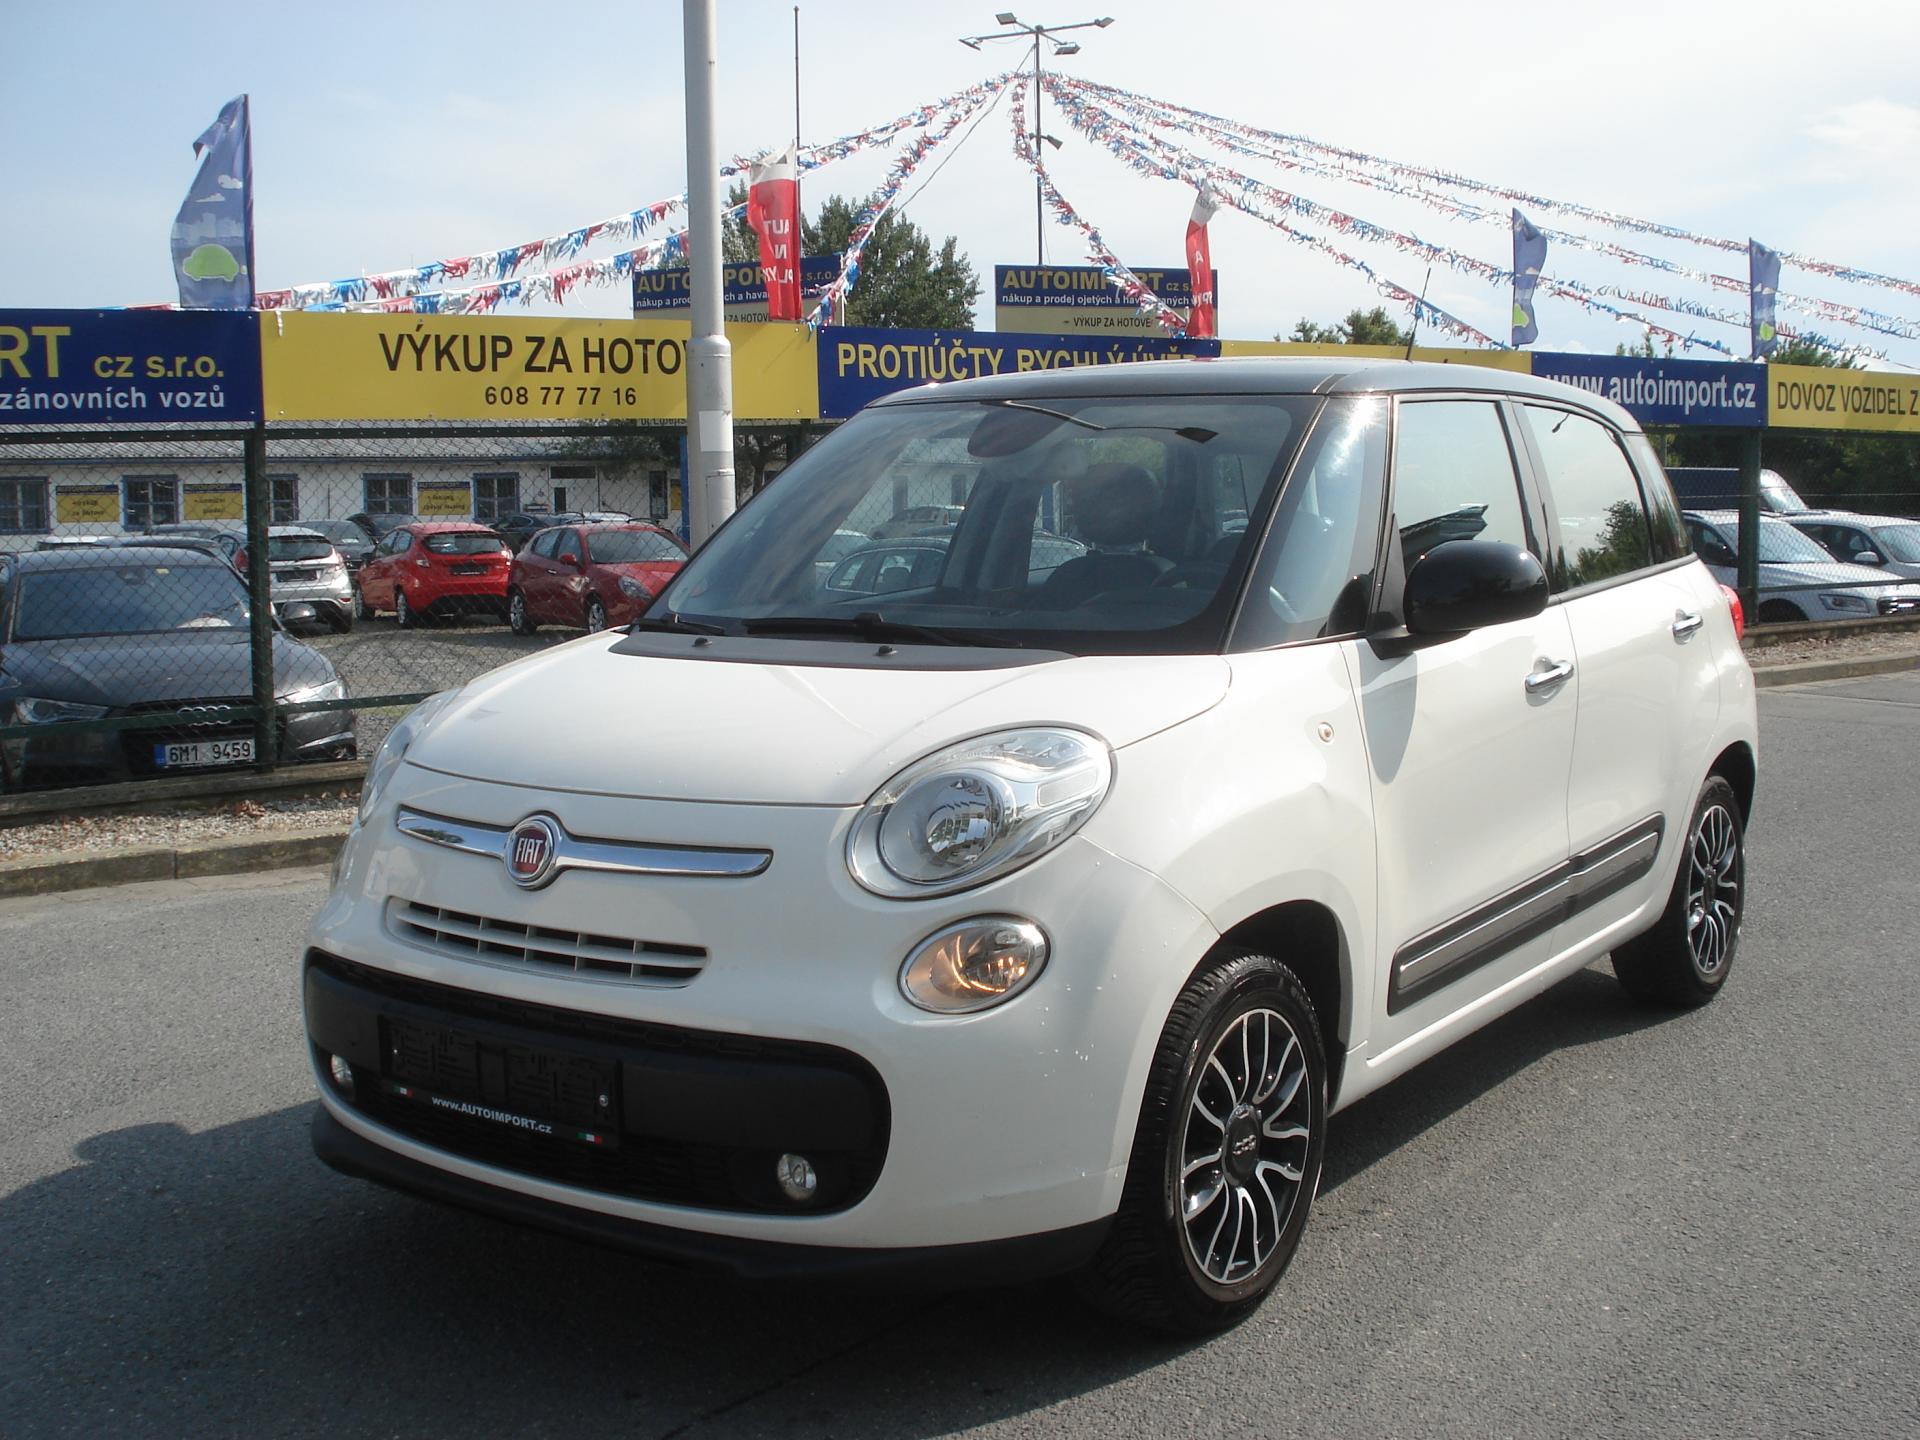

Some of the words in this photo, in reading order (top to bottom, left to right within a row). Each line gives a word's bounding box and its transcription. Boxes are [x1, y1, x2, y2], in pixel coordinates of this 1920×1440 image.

[1002, 293, 1033, 305] nákup
[1035, 295, 1042, 303] a
[1044, 294, 1075, 306] prodej
[1077, 295, 1112, 306] ojetých
[1103, 317, 1115, 328] ZA
[379, 324, 513, 372] VÝKUP
[524, 336, 573, 373] ZA
[583, 336, 688, 375] HOTO
[837, 338, 1004, 379] PROTIÚČTY
[94, 355, 134, 378] cz
[146, 355, 225, 378] s.r.o.
[0, 386, 147, 410] zánovních
[159, 384, 225, 408] vozů
[484, 386, 529, 406] 608
[540, 387, 565, 406] 77
[576, 387, 601, 406] 77
[612, 387, 637, 406] 16
[1777, 381, 1836, 412] DOVOZ
[1840, 385, 1906, 415] VOZIDEL
[1909, 389, 1919, 416] Z
[169, 745, 198, 762] 6M1
[212, 742, 251, 759] 9459
[515, 837, 544, 865] FIAT
[431, 1096, 553, 1134] www.AUTOIMPORT.cz
